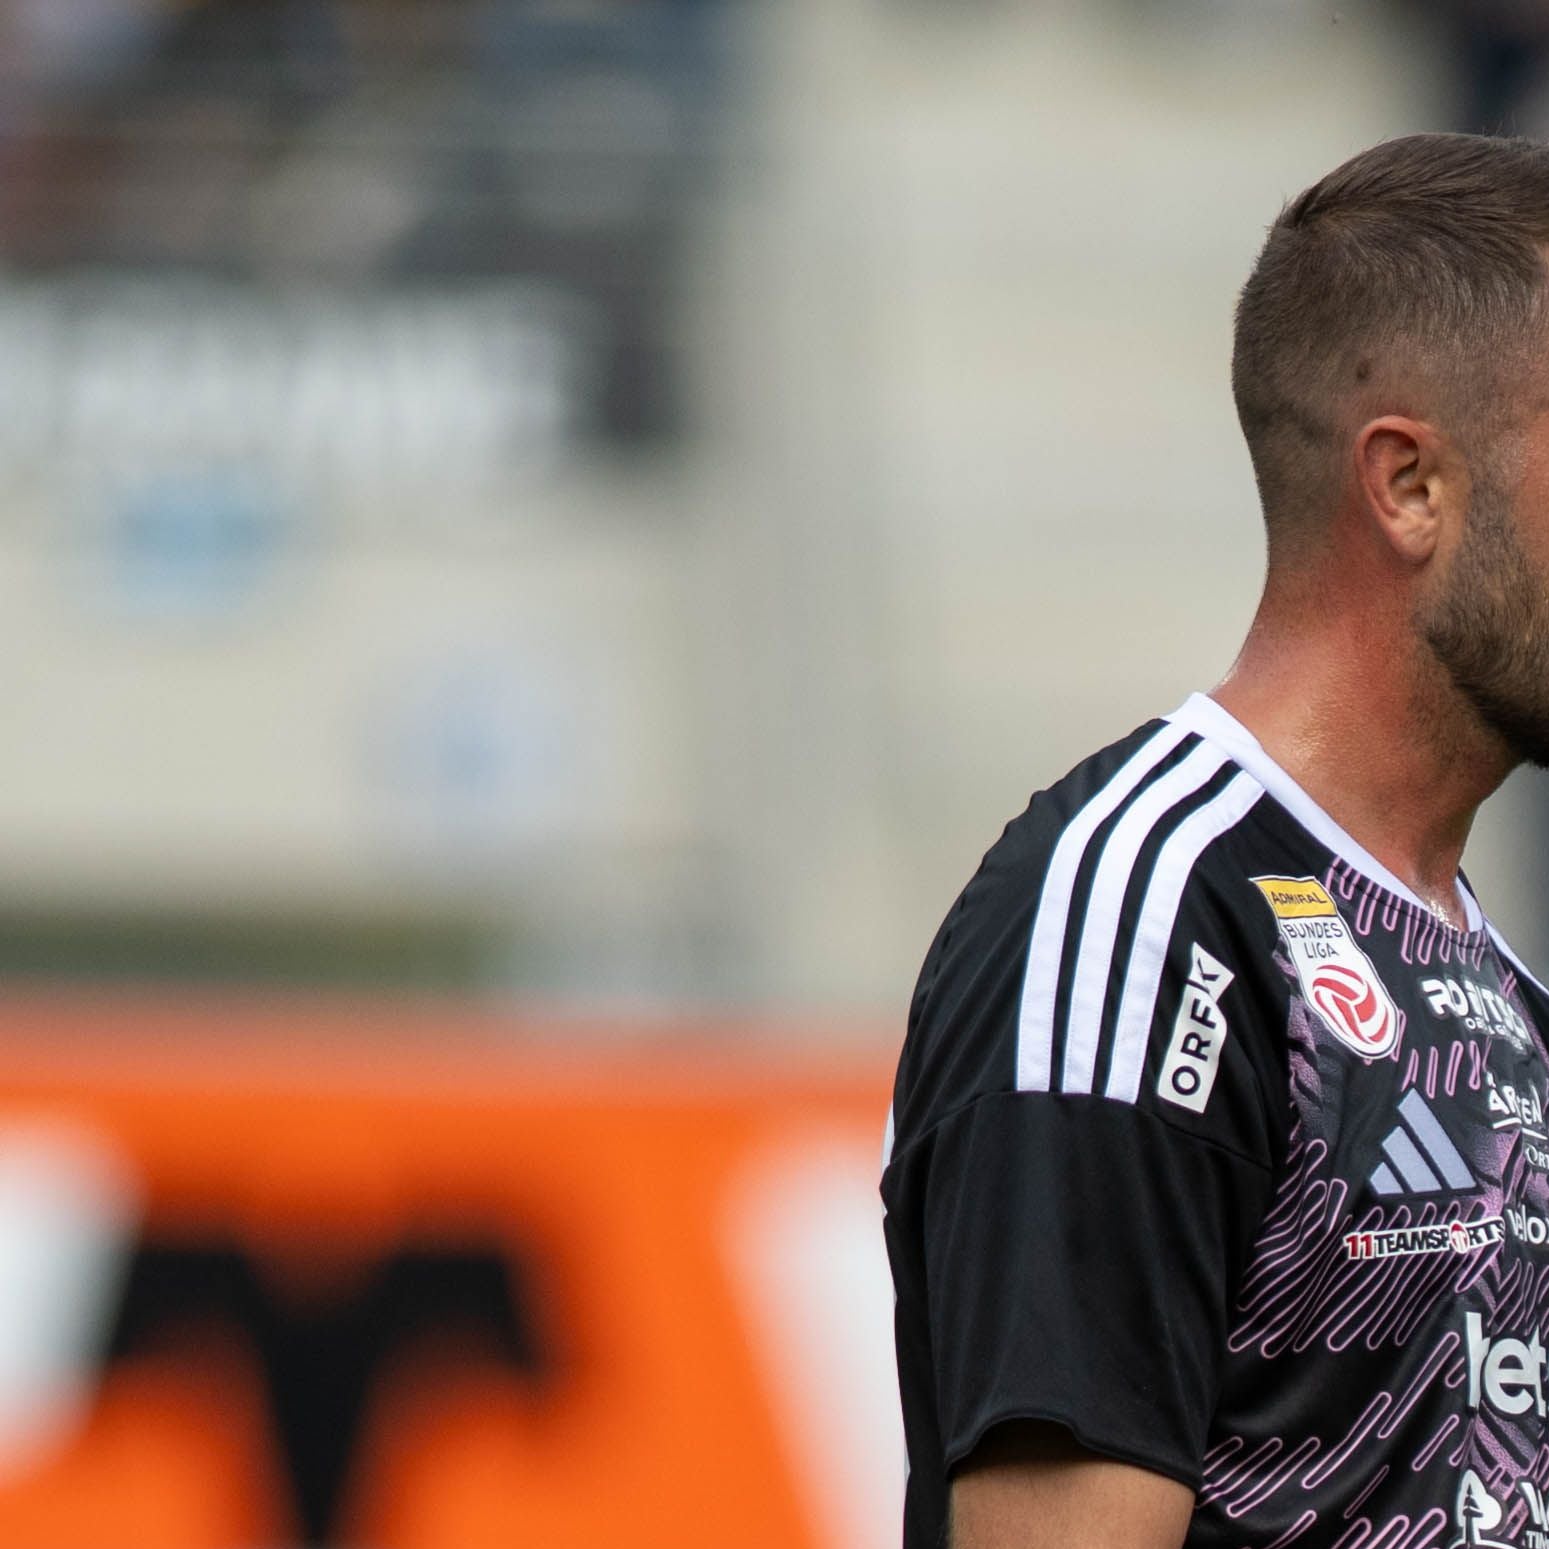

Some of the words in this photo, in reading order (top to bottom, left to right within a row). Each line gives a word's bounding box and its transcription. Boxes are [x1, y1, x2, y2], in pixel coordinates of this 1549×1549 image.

[1272, 890, 1327, 905] ADMIRAL
[1283, 921, 1343, 939] BUNDES
[1304, 941, 1340, 960] LIGA
